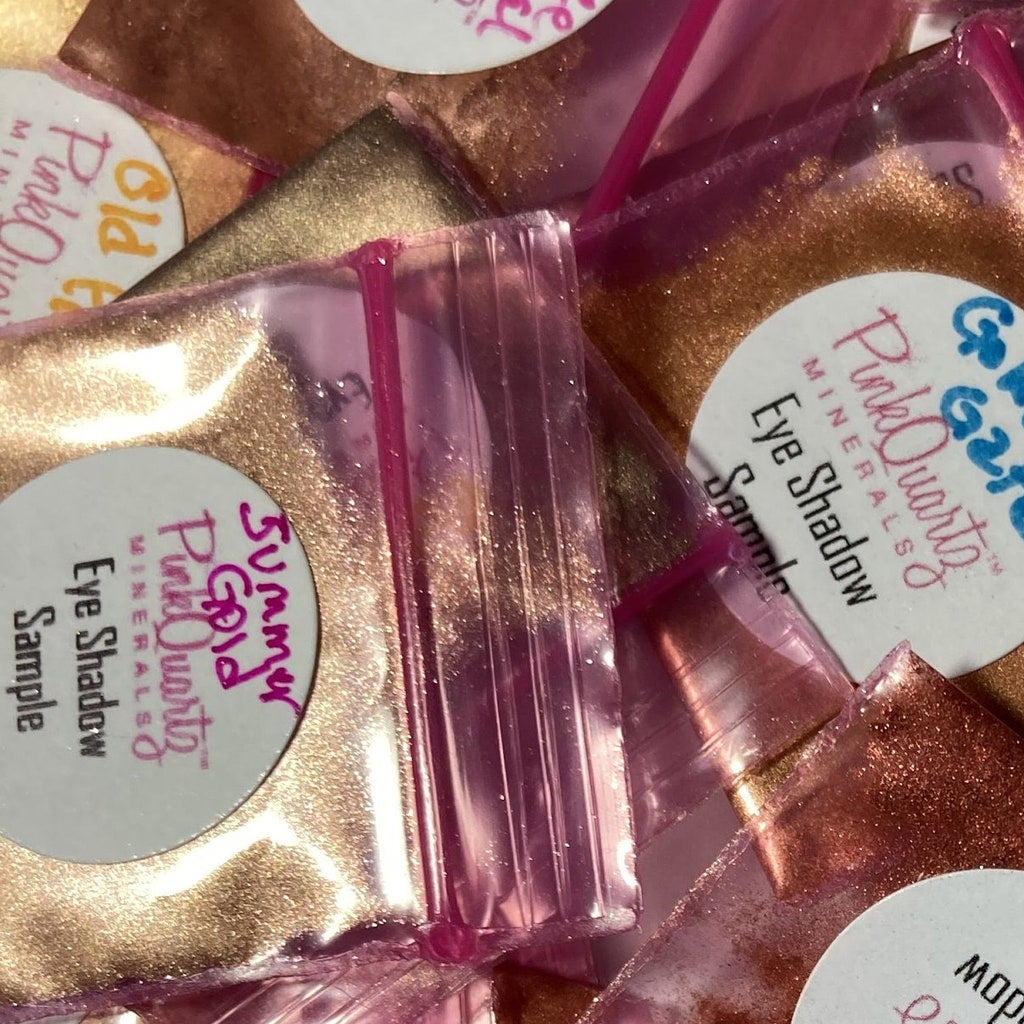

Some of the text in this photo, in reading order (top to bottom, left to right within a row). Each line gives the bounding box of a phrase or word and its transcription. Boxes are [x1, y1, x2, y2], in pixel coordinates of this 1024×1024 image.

[98, 158, 170, 258] Old
[750, 391, 879, 608] Eye Shadow
[801, 355, 909, 557] MINERALS
[12, 605, 58, 733] Sample
[65, 557, 121, 758] Eye Shadow
[129, 534, 152, 729] MINERALS
[207, 564, 267, 690] Gold
[239, 501, 301, 718] Summer
